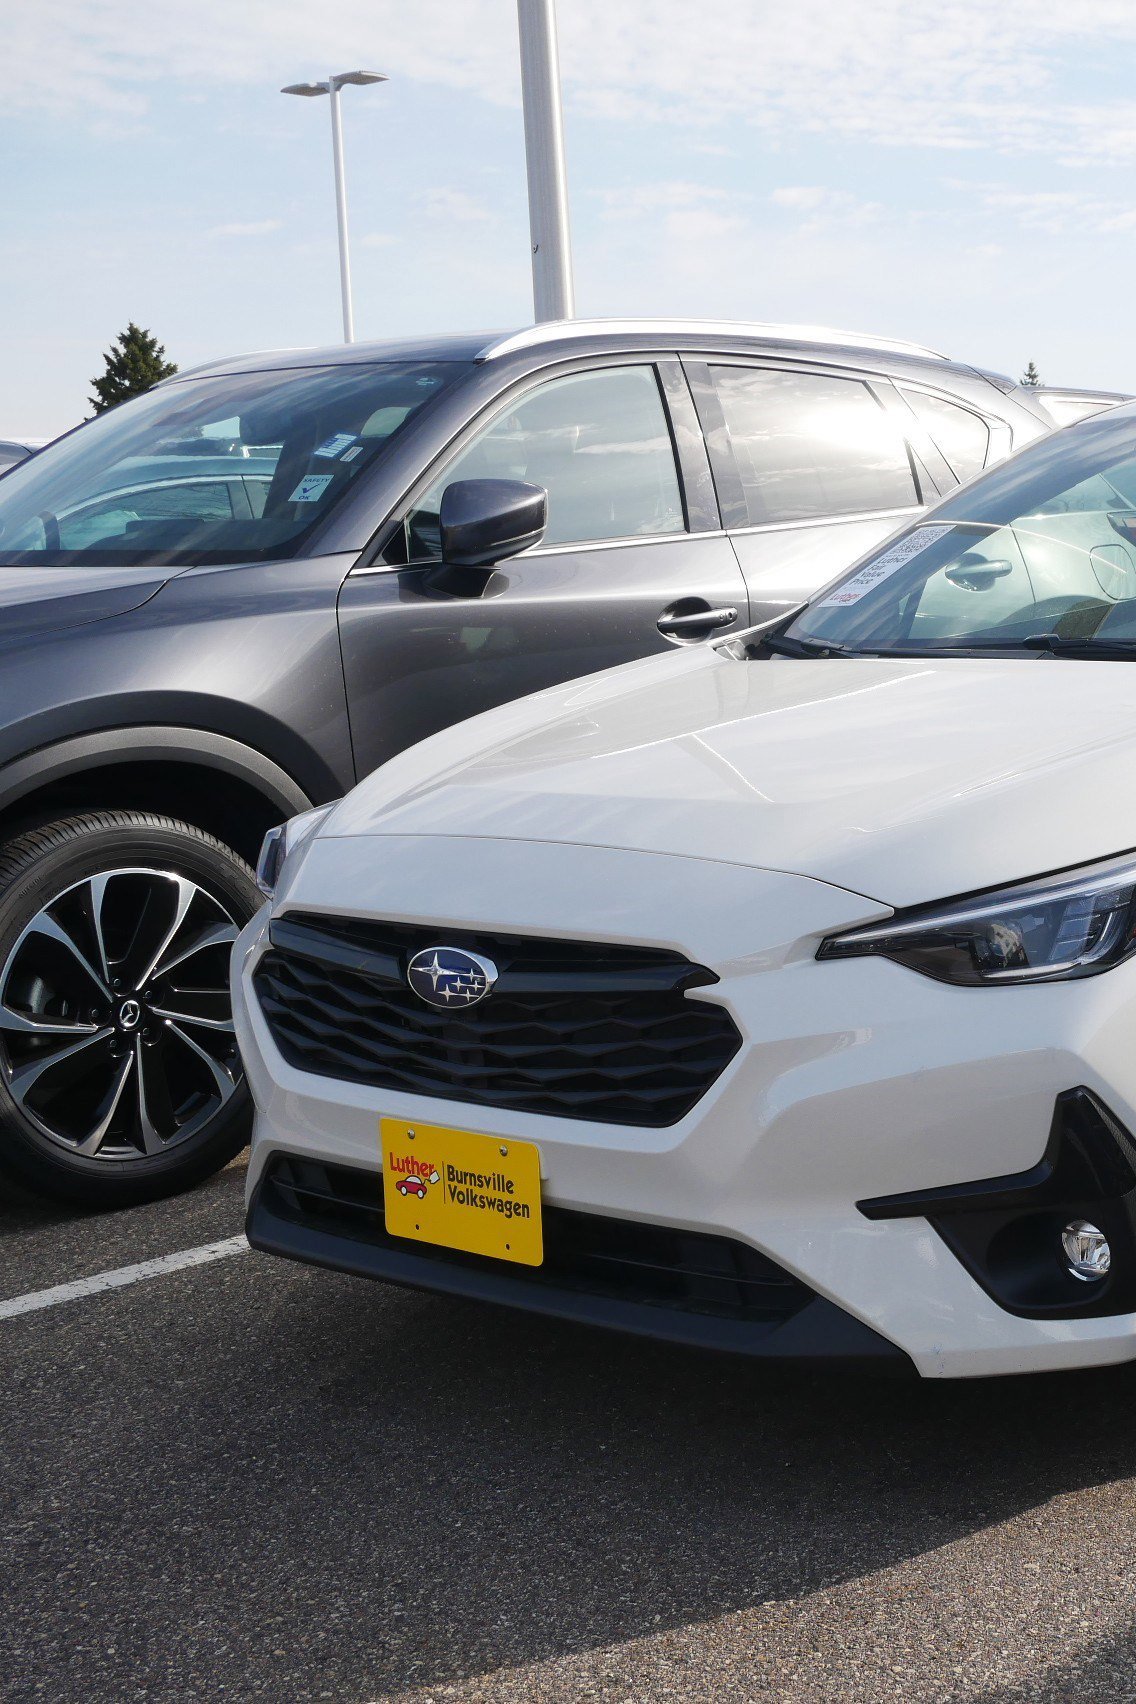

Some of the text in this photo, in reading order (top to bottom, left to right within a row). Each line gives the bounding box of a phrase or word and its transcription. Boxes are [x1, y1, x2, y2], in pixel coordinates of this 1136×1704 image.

[389, 1152, 436, 1178] Luther
[446, 1164, 515, 1195] Burnsville
[447, 1183, 531, 1219] Volkswagen
